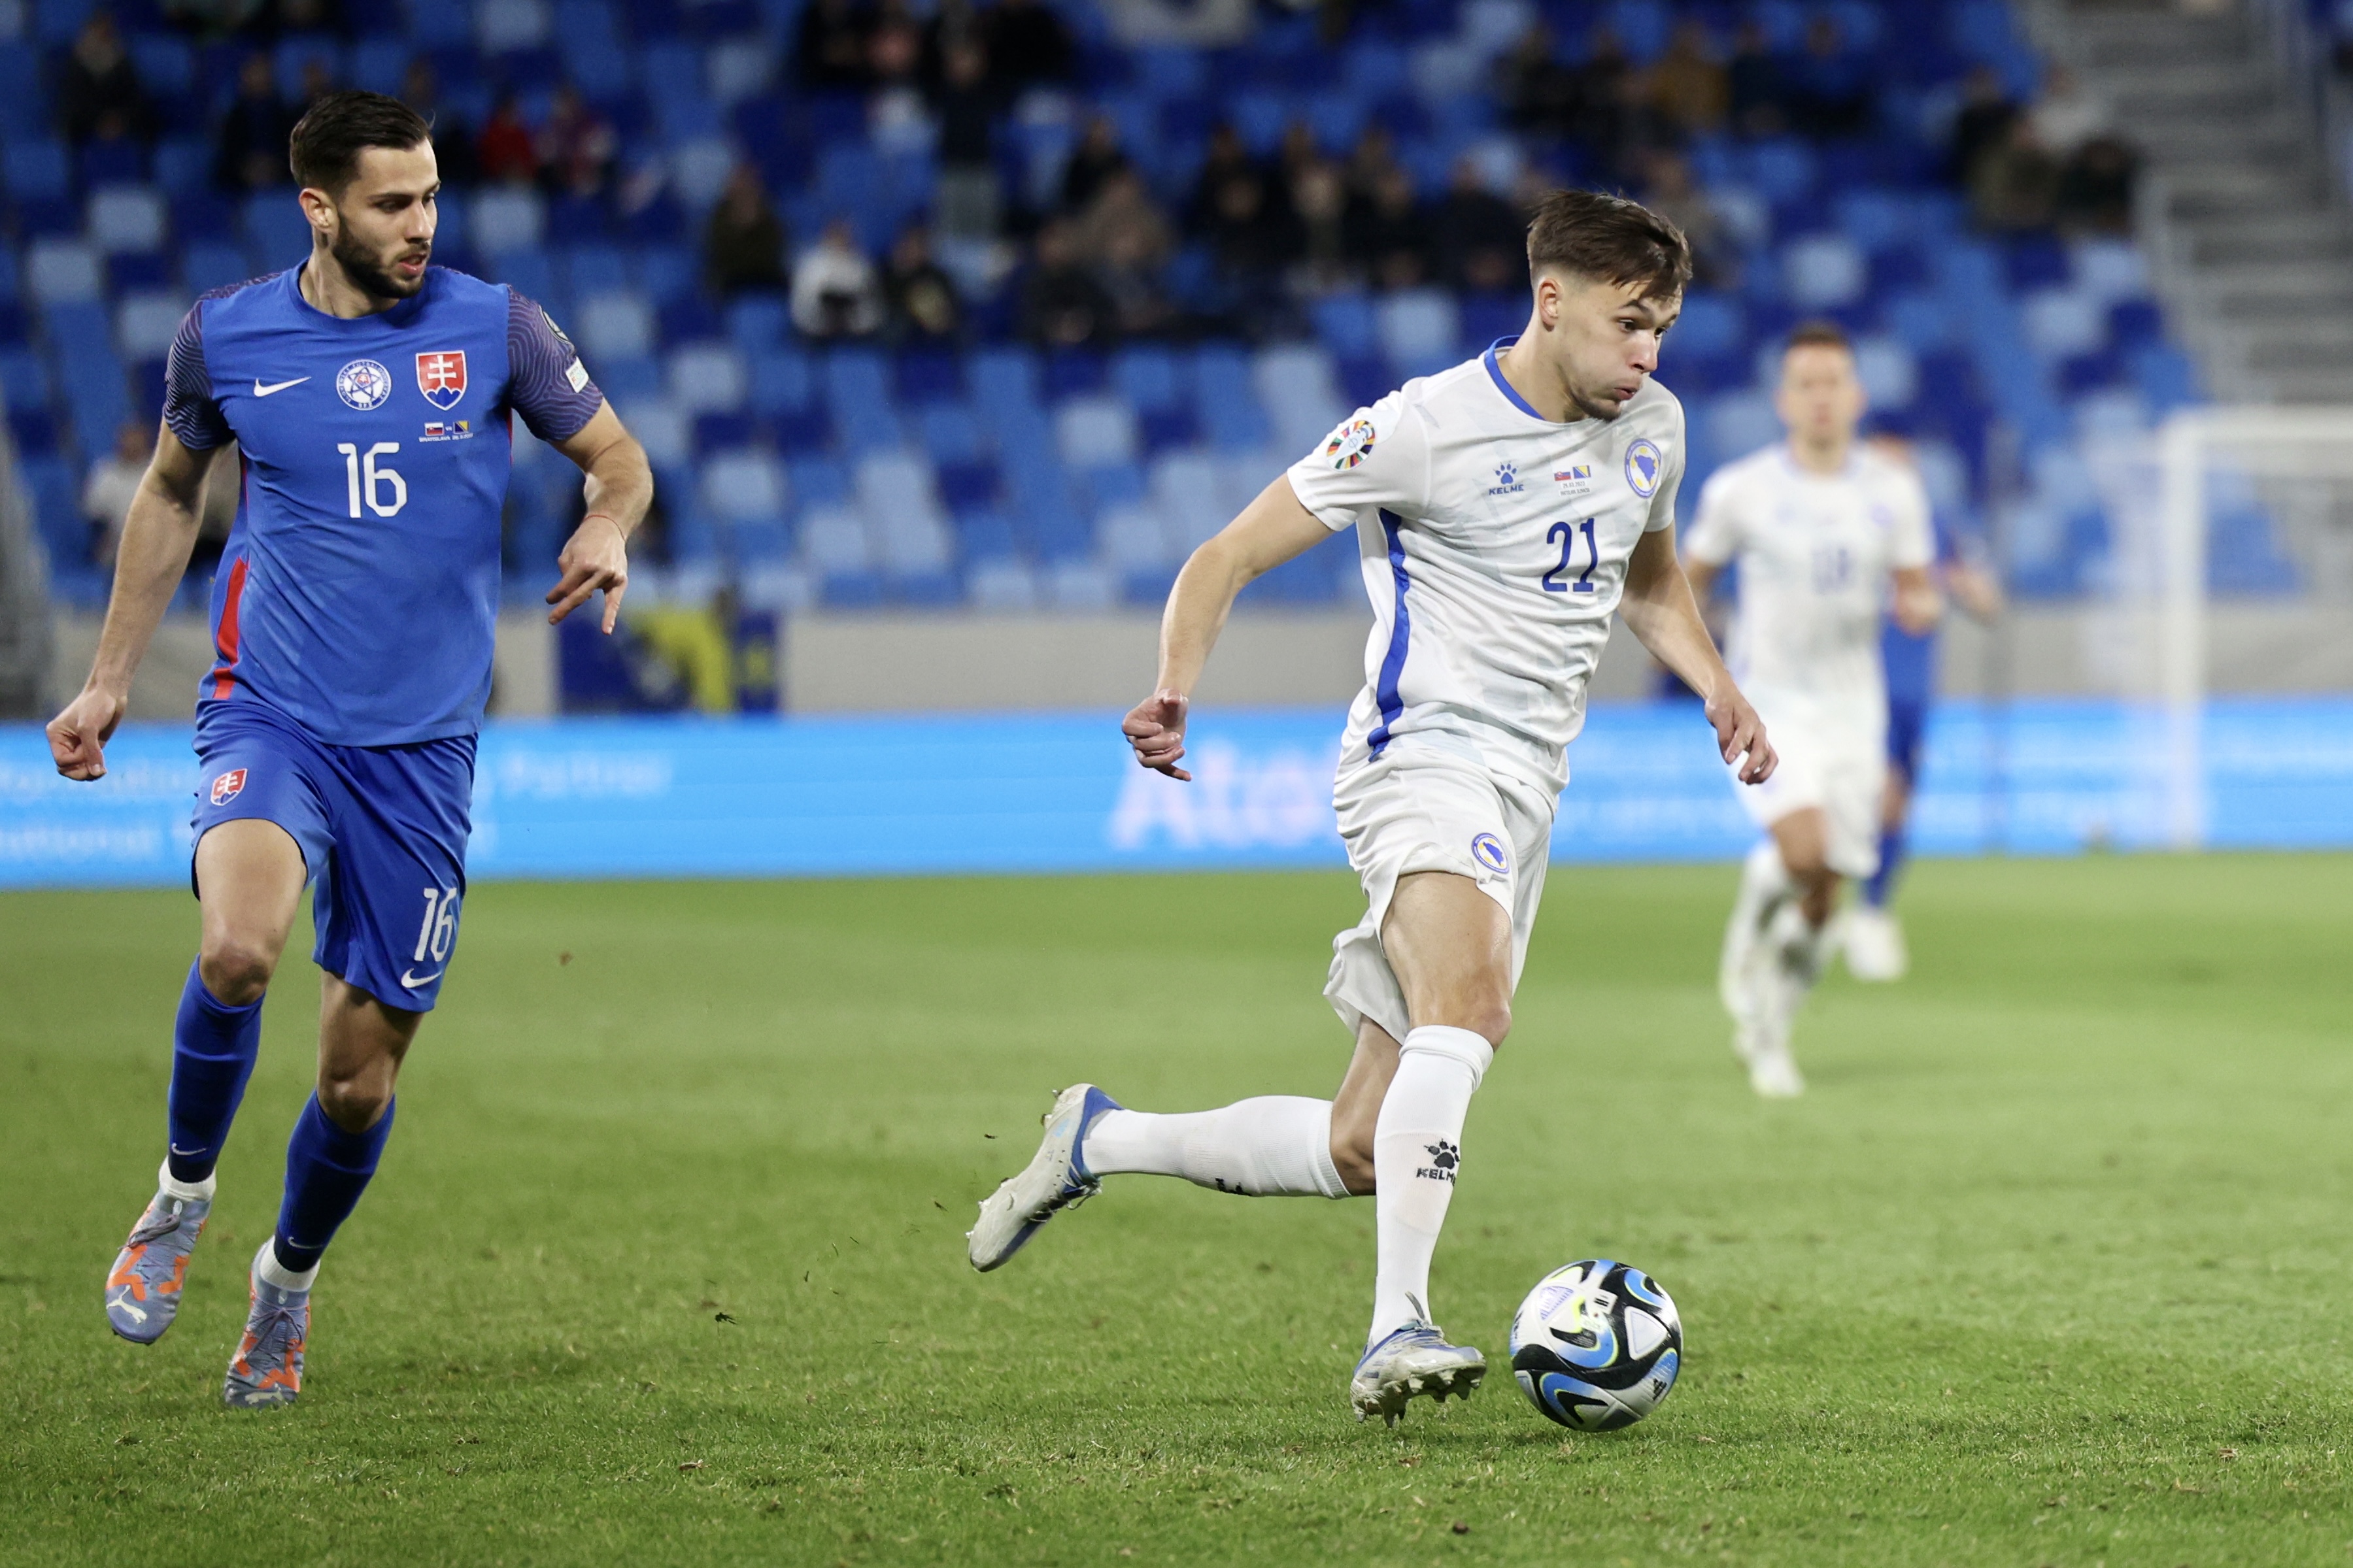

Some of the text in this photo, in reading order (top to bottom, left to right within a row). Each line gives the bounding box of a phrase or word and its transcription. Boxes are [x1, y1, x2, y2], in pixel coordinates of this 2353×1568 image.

[337, 442, 407, 518] 16
[1489, 484, 1525, 495] KELME
[1542, 518, 1599, 592] 21
[414, 888, 457, 962] 16
